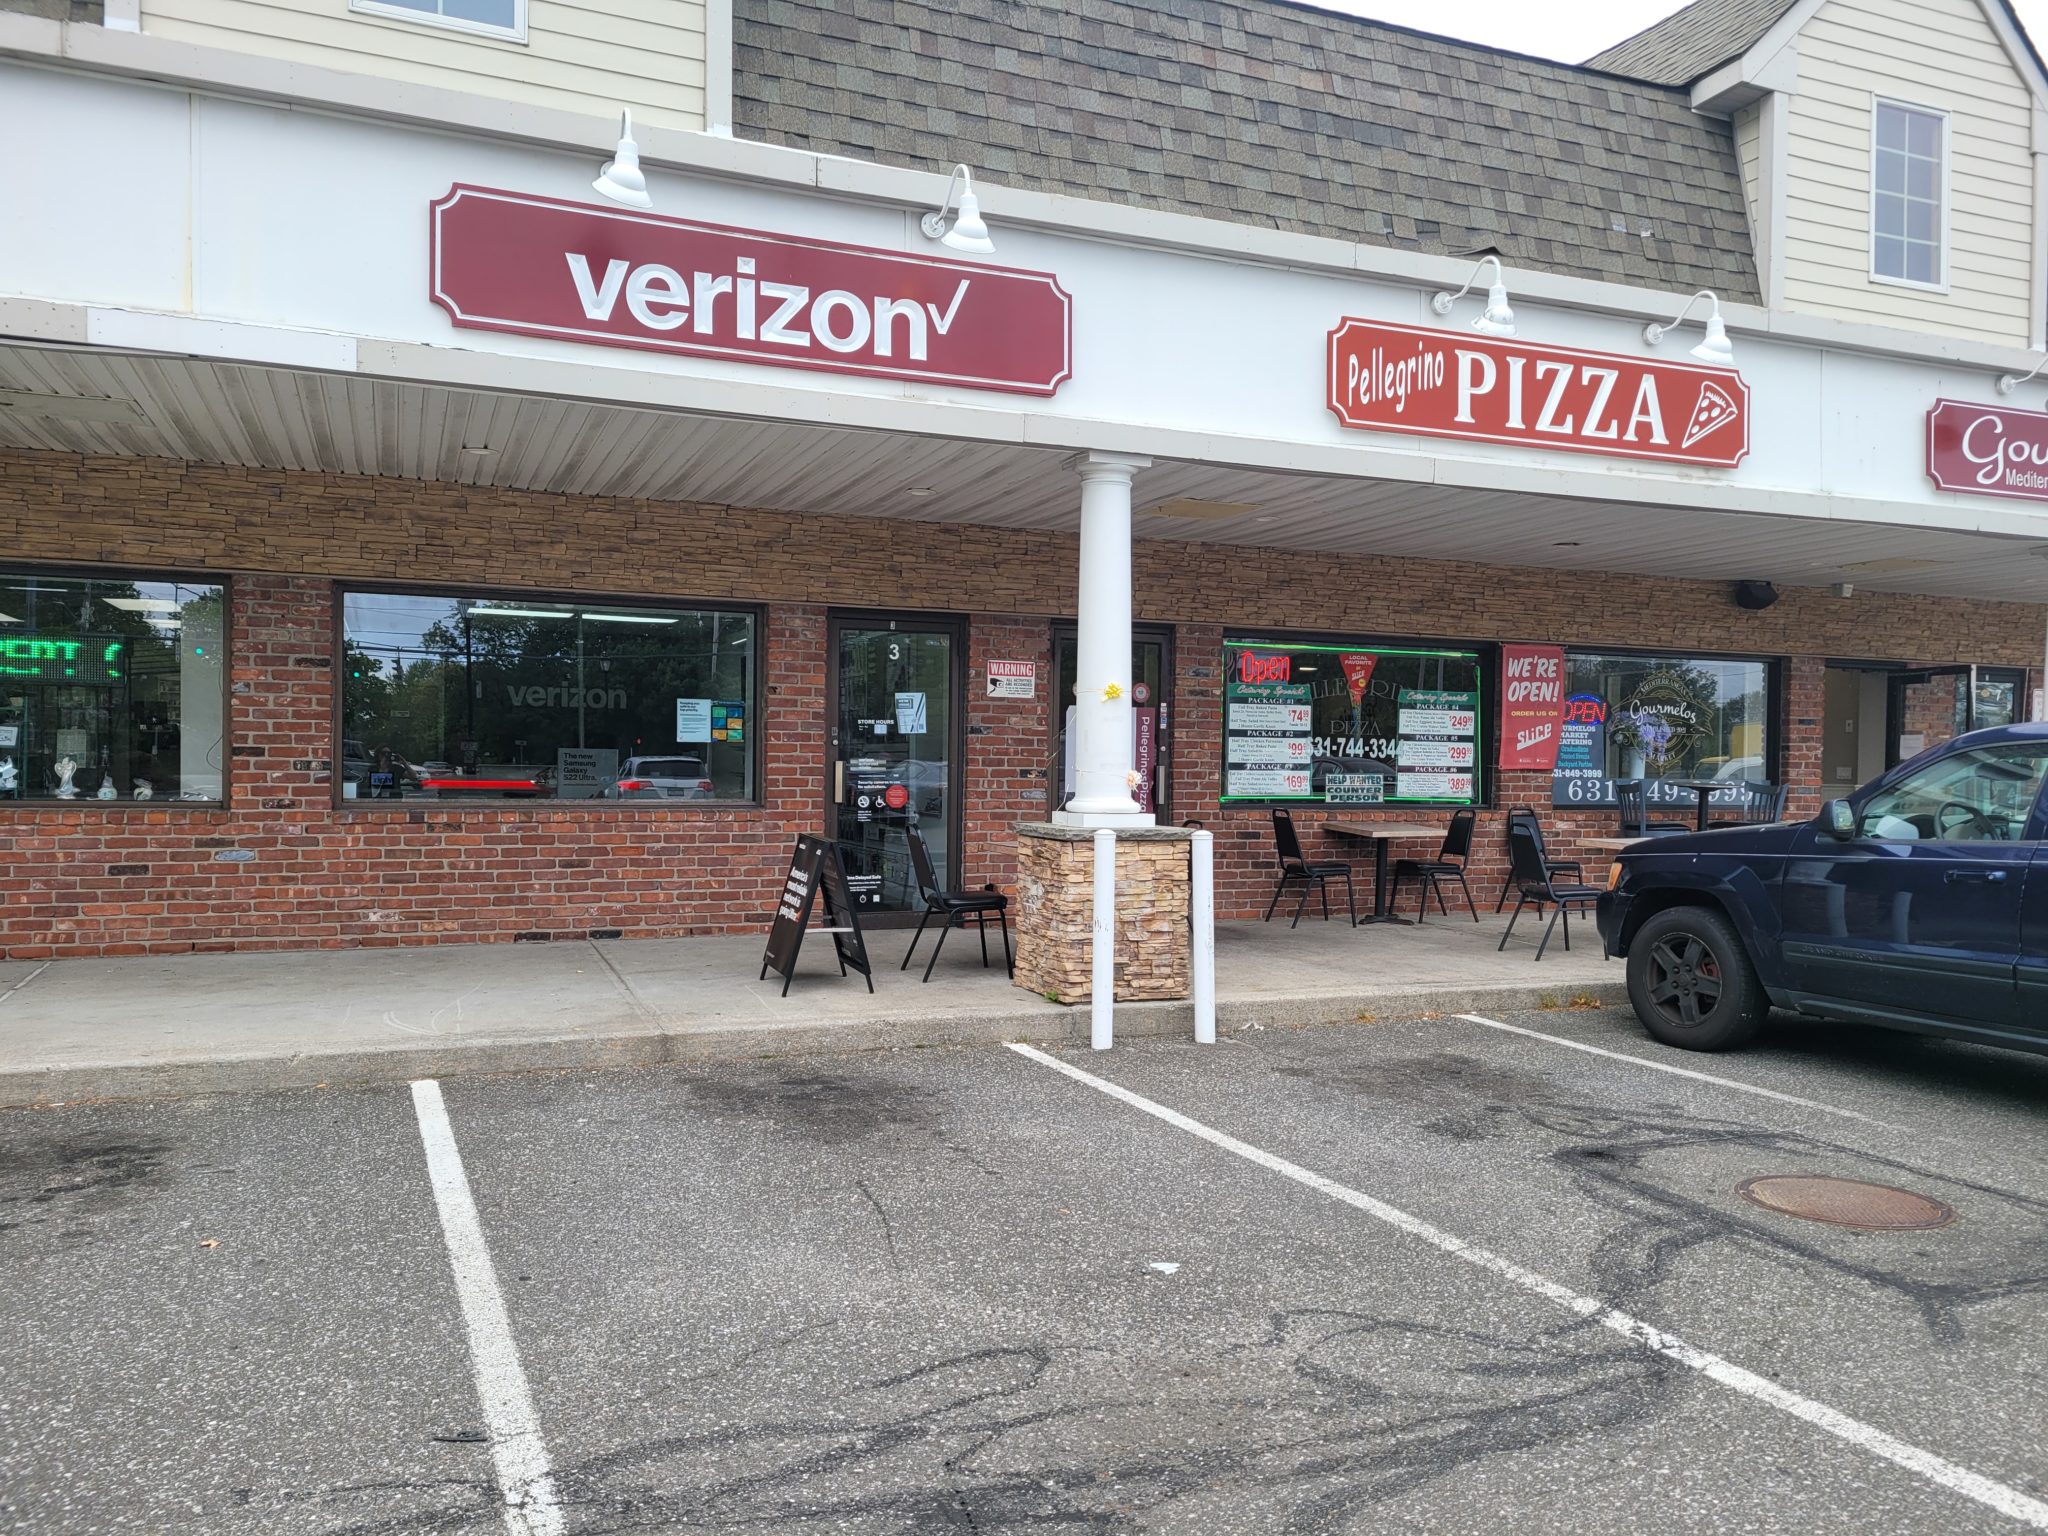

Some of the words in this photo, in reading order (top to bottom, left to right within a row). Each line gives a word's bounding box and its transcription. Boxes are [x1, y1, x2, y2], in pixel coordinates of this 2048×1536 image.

[564, 252, 928, 361] verizon
[1348, 340, 1444, 413] Pellegrino
[1454, 349, 1670, 445] PIZZA
[889, 644, 899, 660] 3
[990, 663, 1032, 676] WARNING
[1242, 650, 1290, 685] Open
[1508, 655, 1558, 678] WE'RE
[506, 681, 627, 709] verizon
[1508, 680, 1560, 702] OPEN!
[1330, 720, 1382, 736] PIZZA
[1327, 775, 1346, 784] HELP
[1349, 776, 1382, 784] WANTED
[1552, 769, 1602, 777] 31-849-3999
